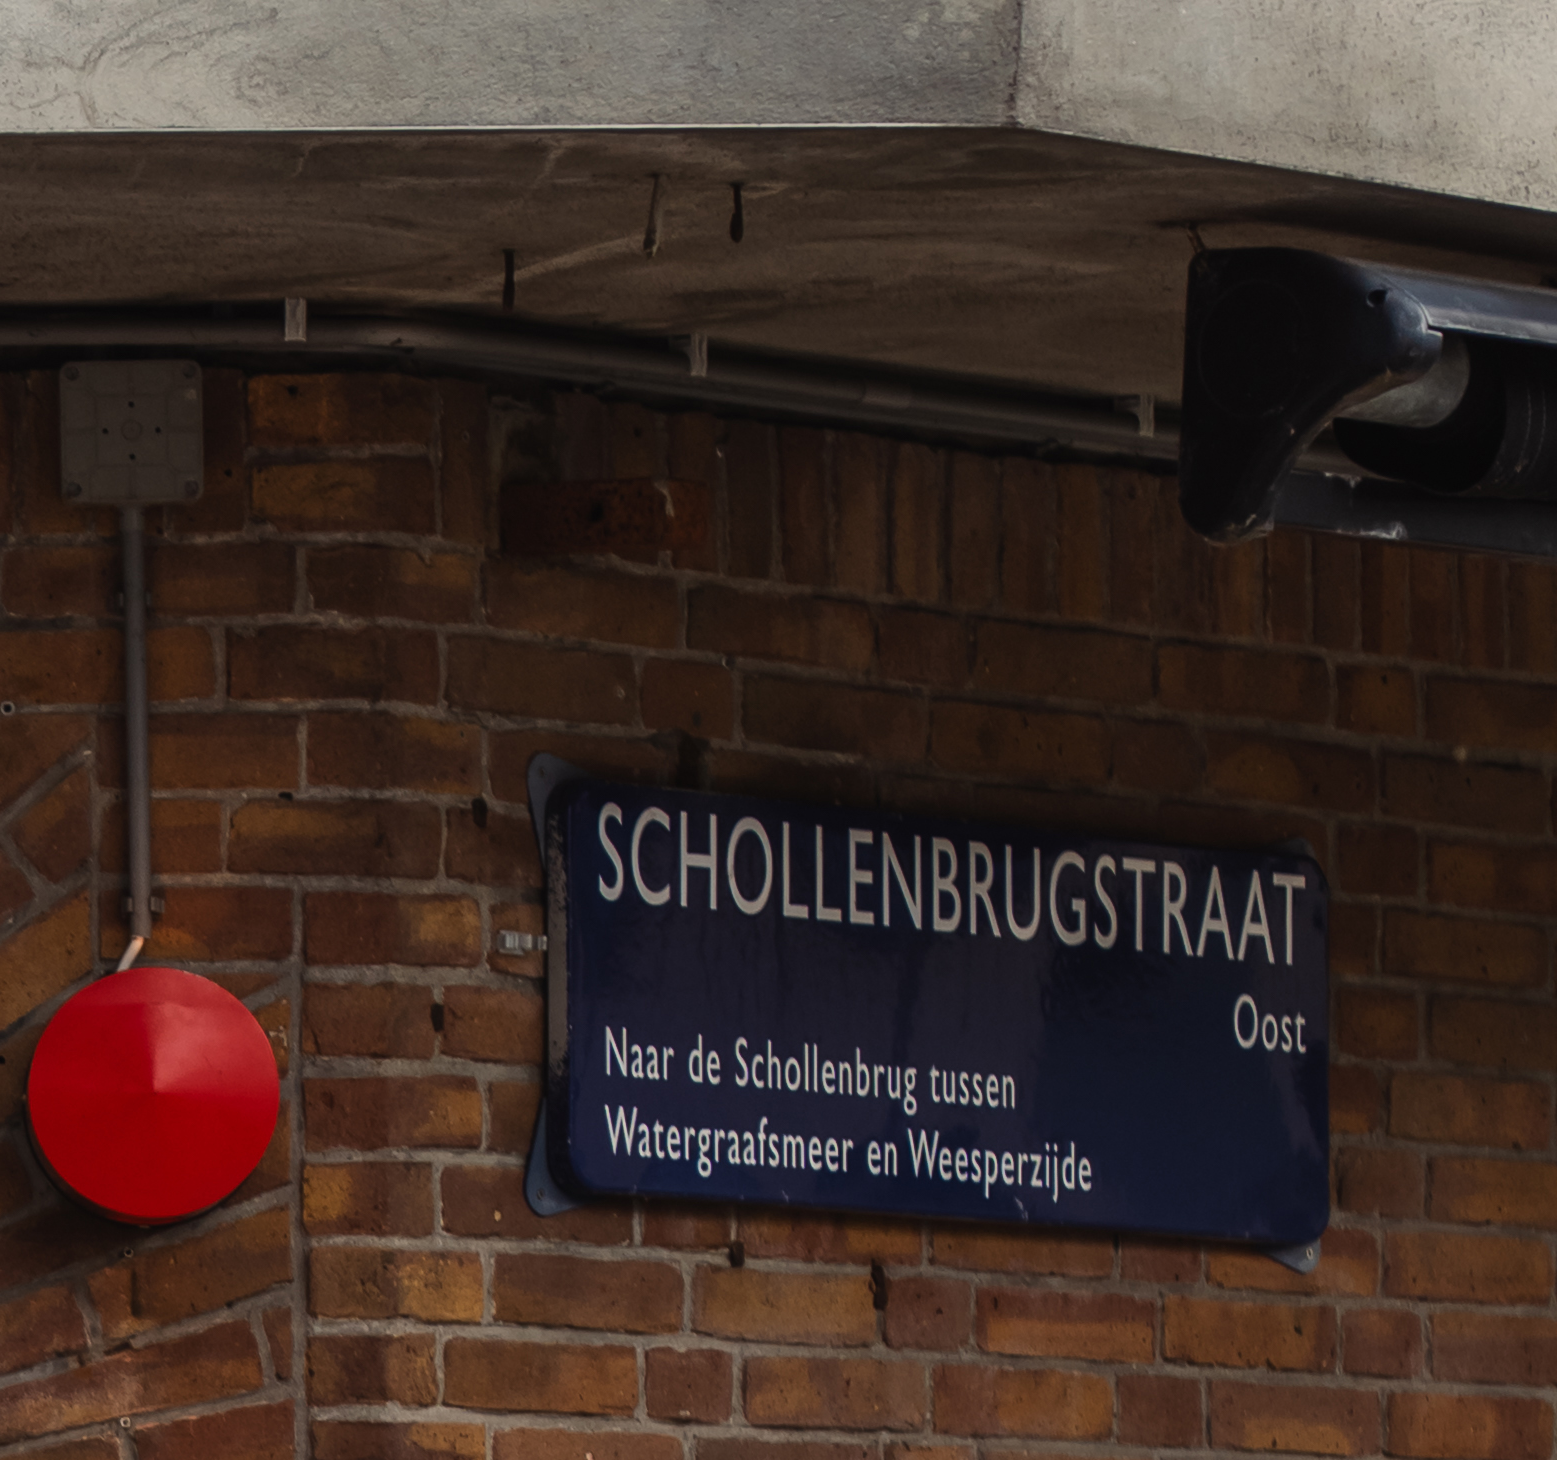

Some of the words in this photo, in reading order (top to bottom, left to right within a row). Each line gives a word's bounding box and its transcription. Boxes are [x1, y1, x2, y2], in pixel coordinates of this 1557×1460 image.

[598, 802, 1306, 966] SCHOLLENBRUGSTRAAT
[605, 1025, 675, 1082] Naar
[688, 1033, 721, 1087] de
[734, 1036, 918, 1116] Schollenbrug
[929, 1064, 1016, 1110] tussen
[1233, 993, 1307, 1054] Oost
[603, 1103, 854, 1178] Watergraafsmeer
[867, 1140, 898, 1177] en
[907, 1127, 1092, 1204] Weesperzijde
